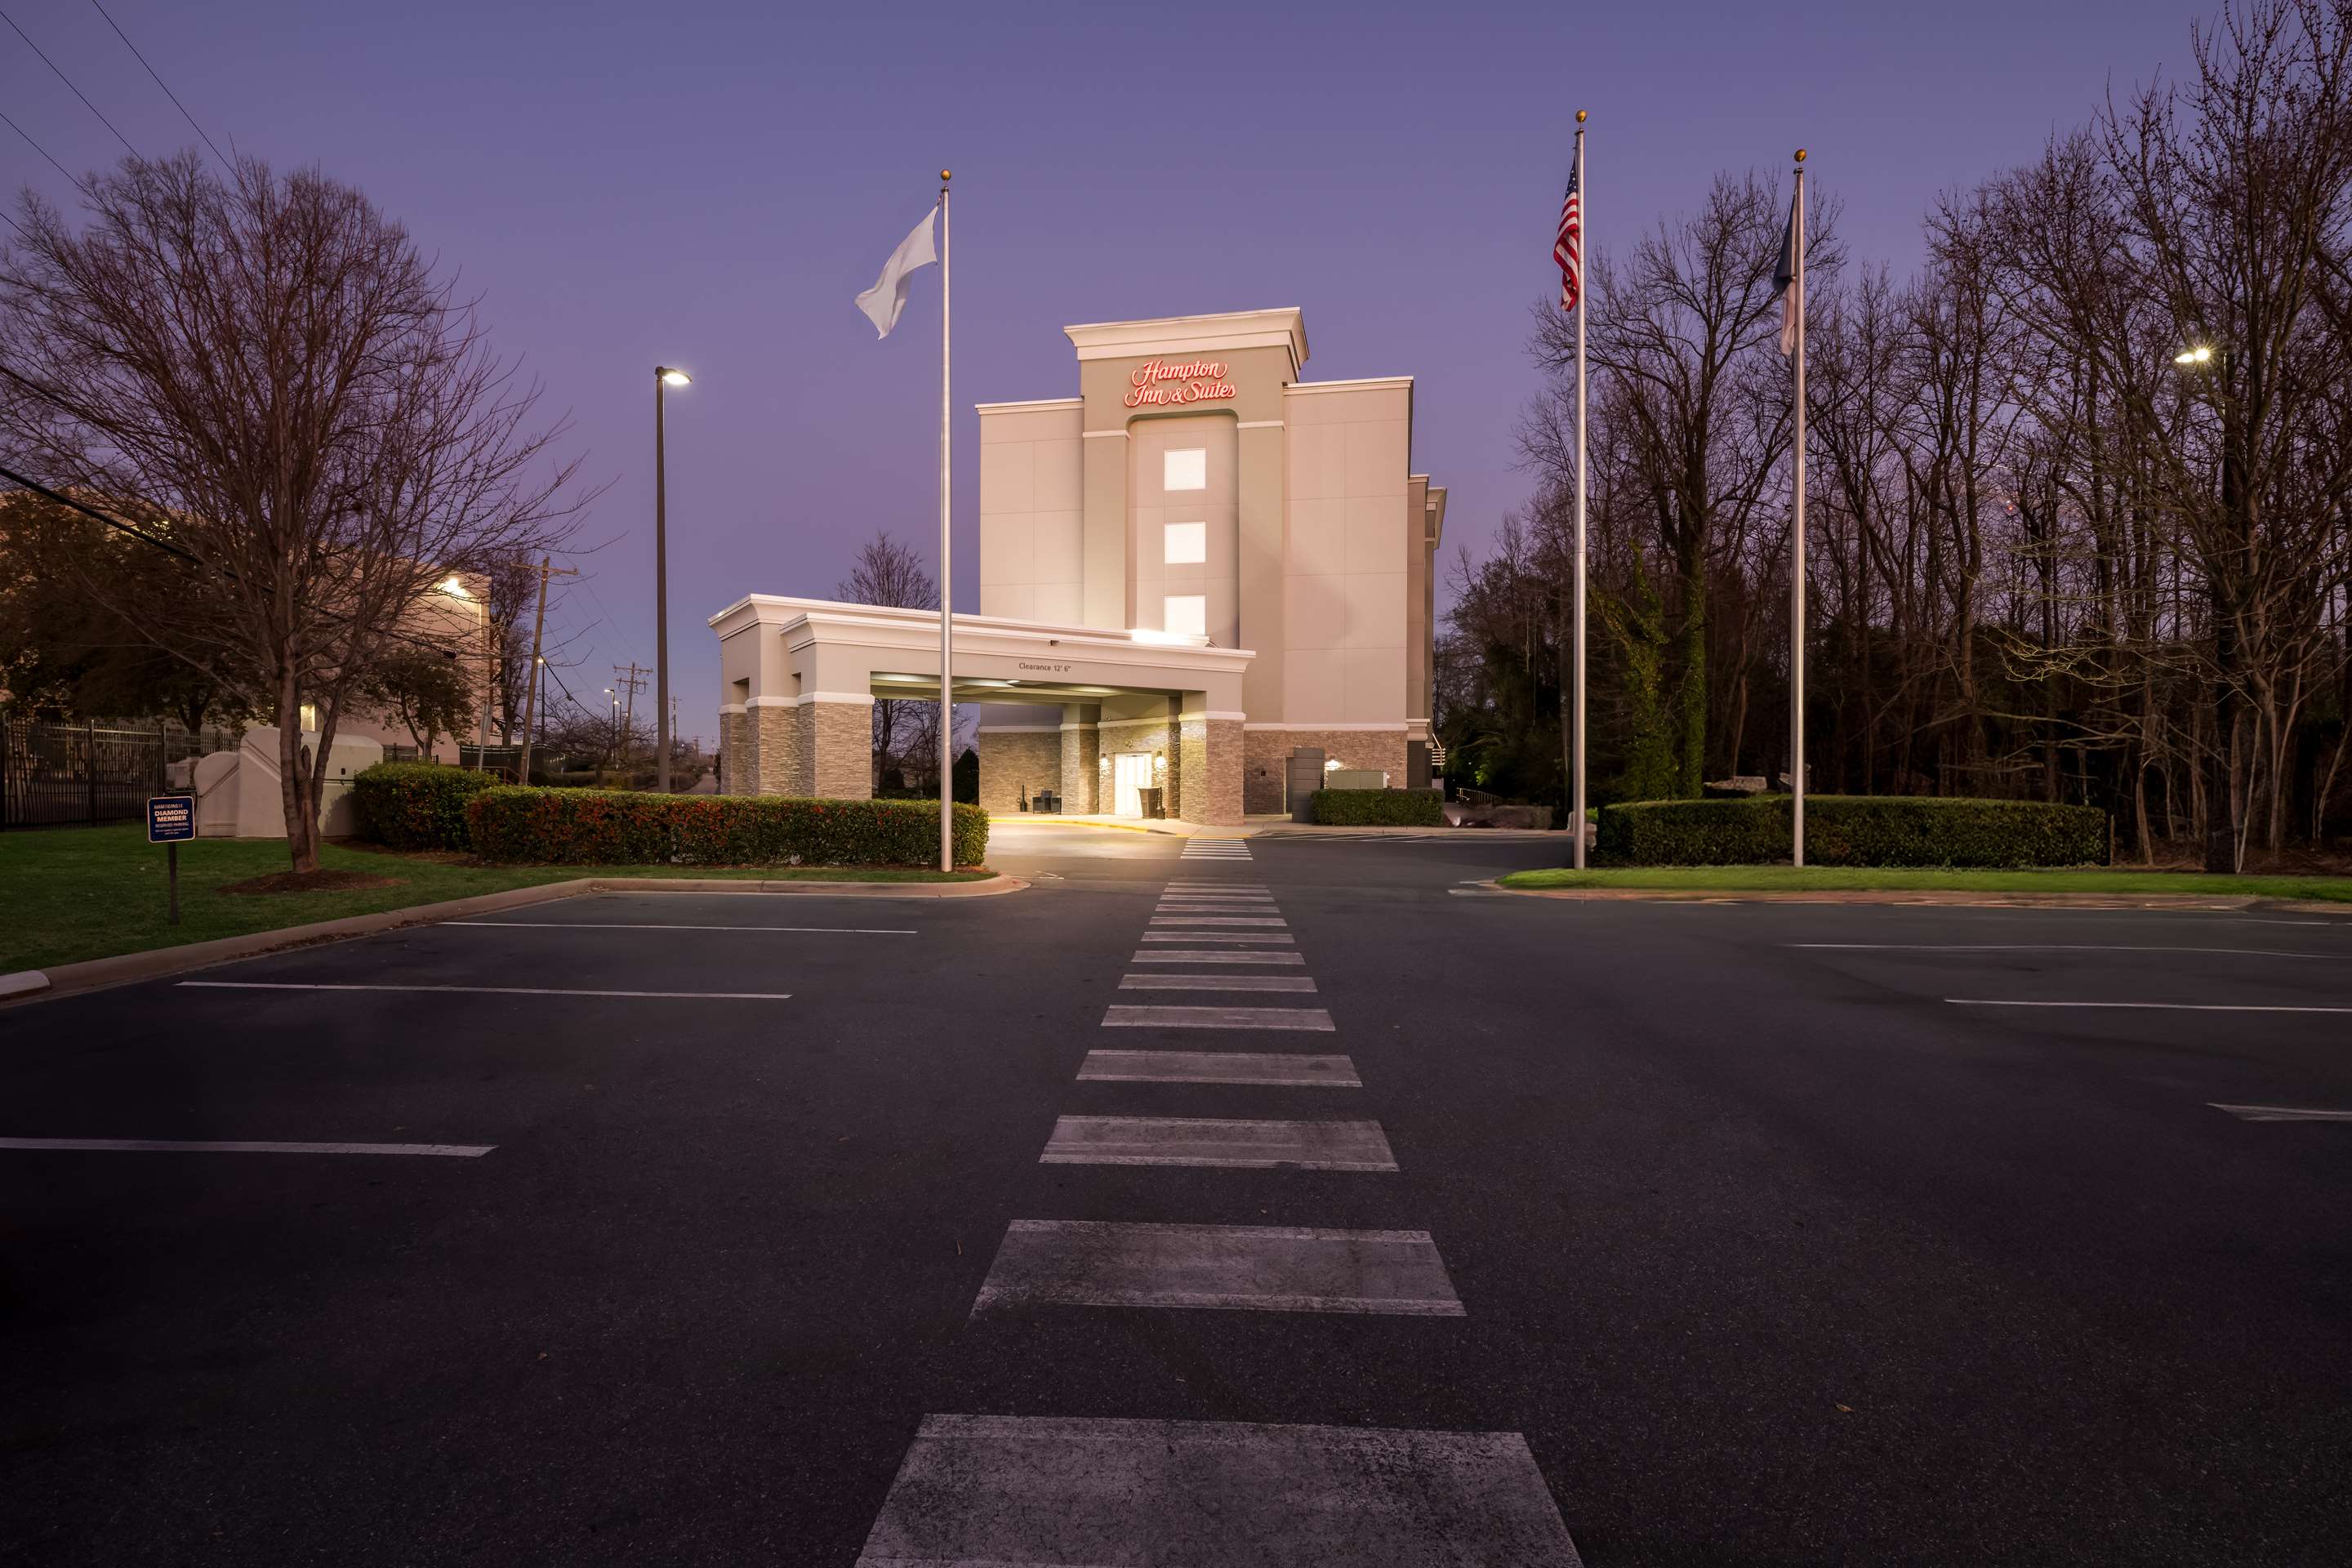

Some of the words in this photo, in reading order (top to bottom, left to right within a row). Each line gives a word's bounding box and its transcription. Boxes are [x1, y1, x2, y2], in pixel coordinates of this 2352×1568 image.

[1131, 360, 1228, 386] Hampton
[1124, 385, 1171, 407] Inn
[1171, 387, 1185, 403] &
[1184, 381, 1236, 401] Suites
[1019, 662, 1052, 671] Clearance
